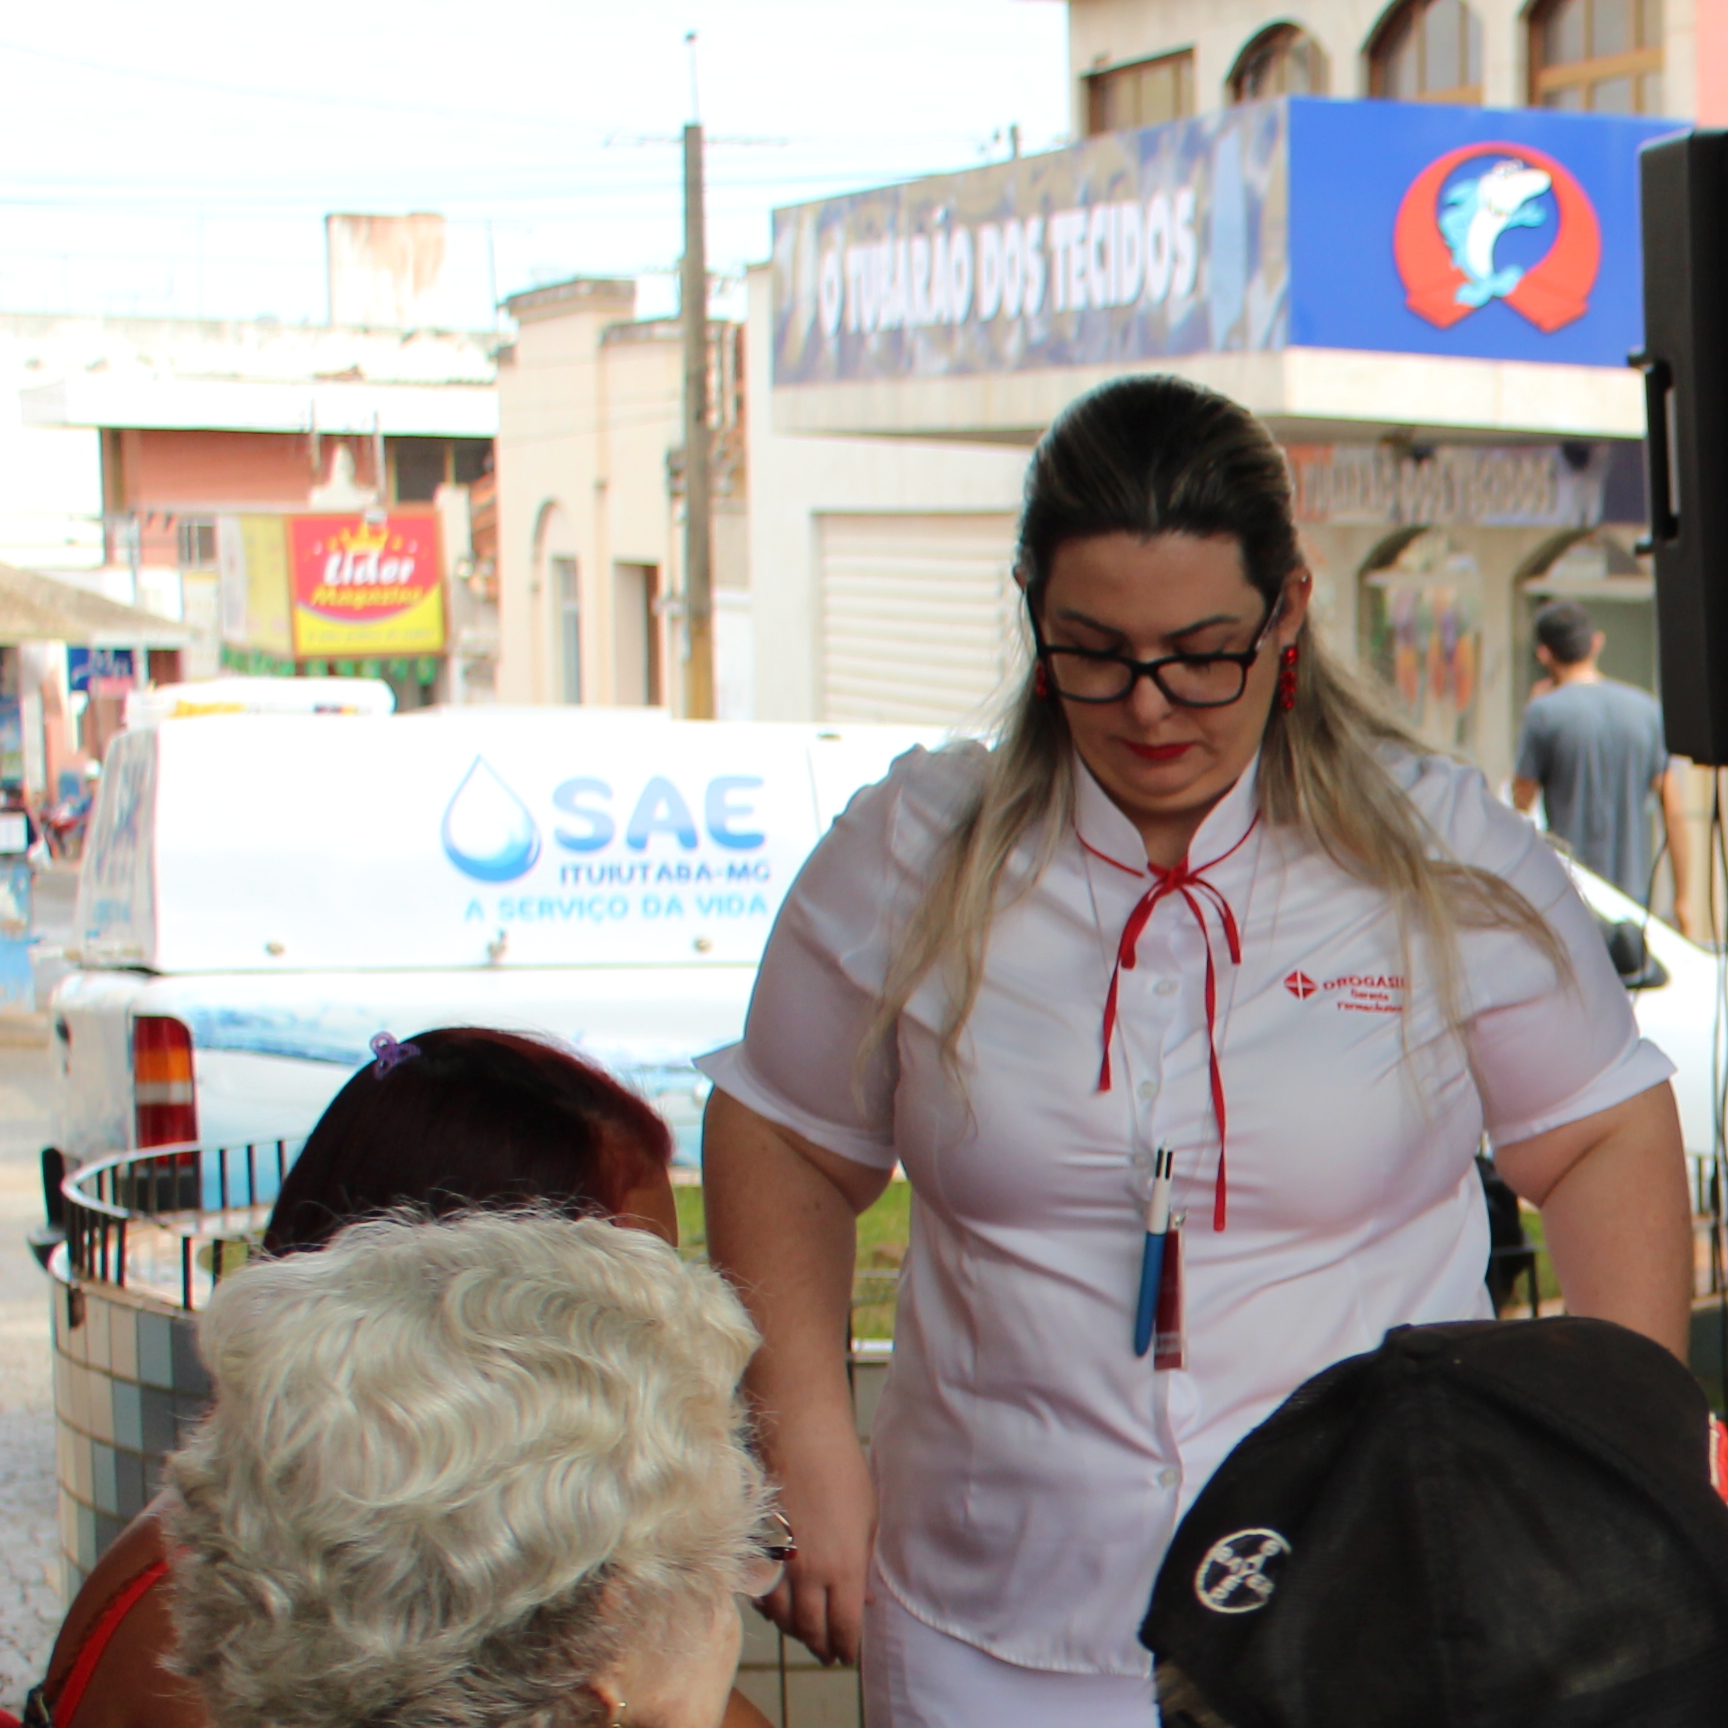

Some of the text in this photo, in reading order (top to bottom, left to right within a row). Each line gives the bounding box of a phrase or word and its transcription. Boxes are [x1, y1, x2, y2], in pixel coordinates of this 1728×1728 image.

[844, 207, 974, 335] TUBARÃO
[976, 214, 1048, 323] DOS
[1048, 188, 1200, 314] TECIDOS
[552, 774, 768, 851] SAE
[560, 858, 773, 885] ITUIUTABA-MG
[465, 893, 769, 926] A SERVIÇO DA VIDA
